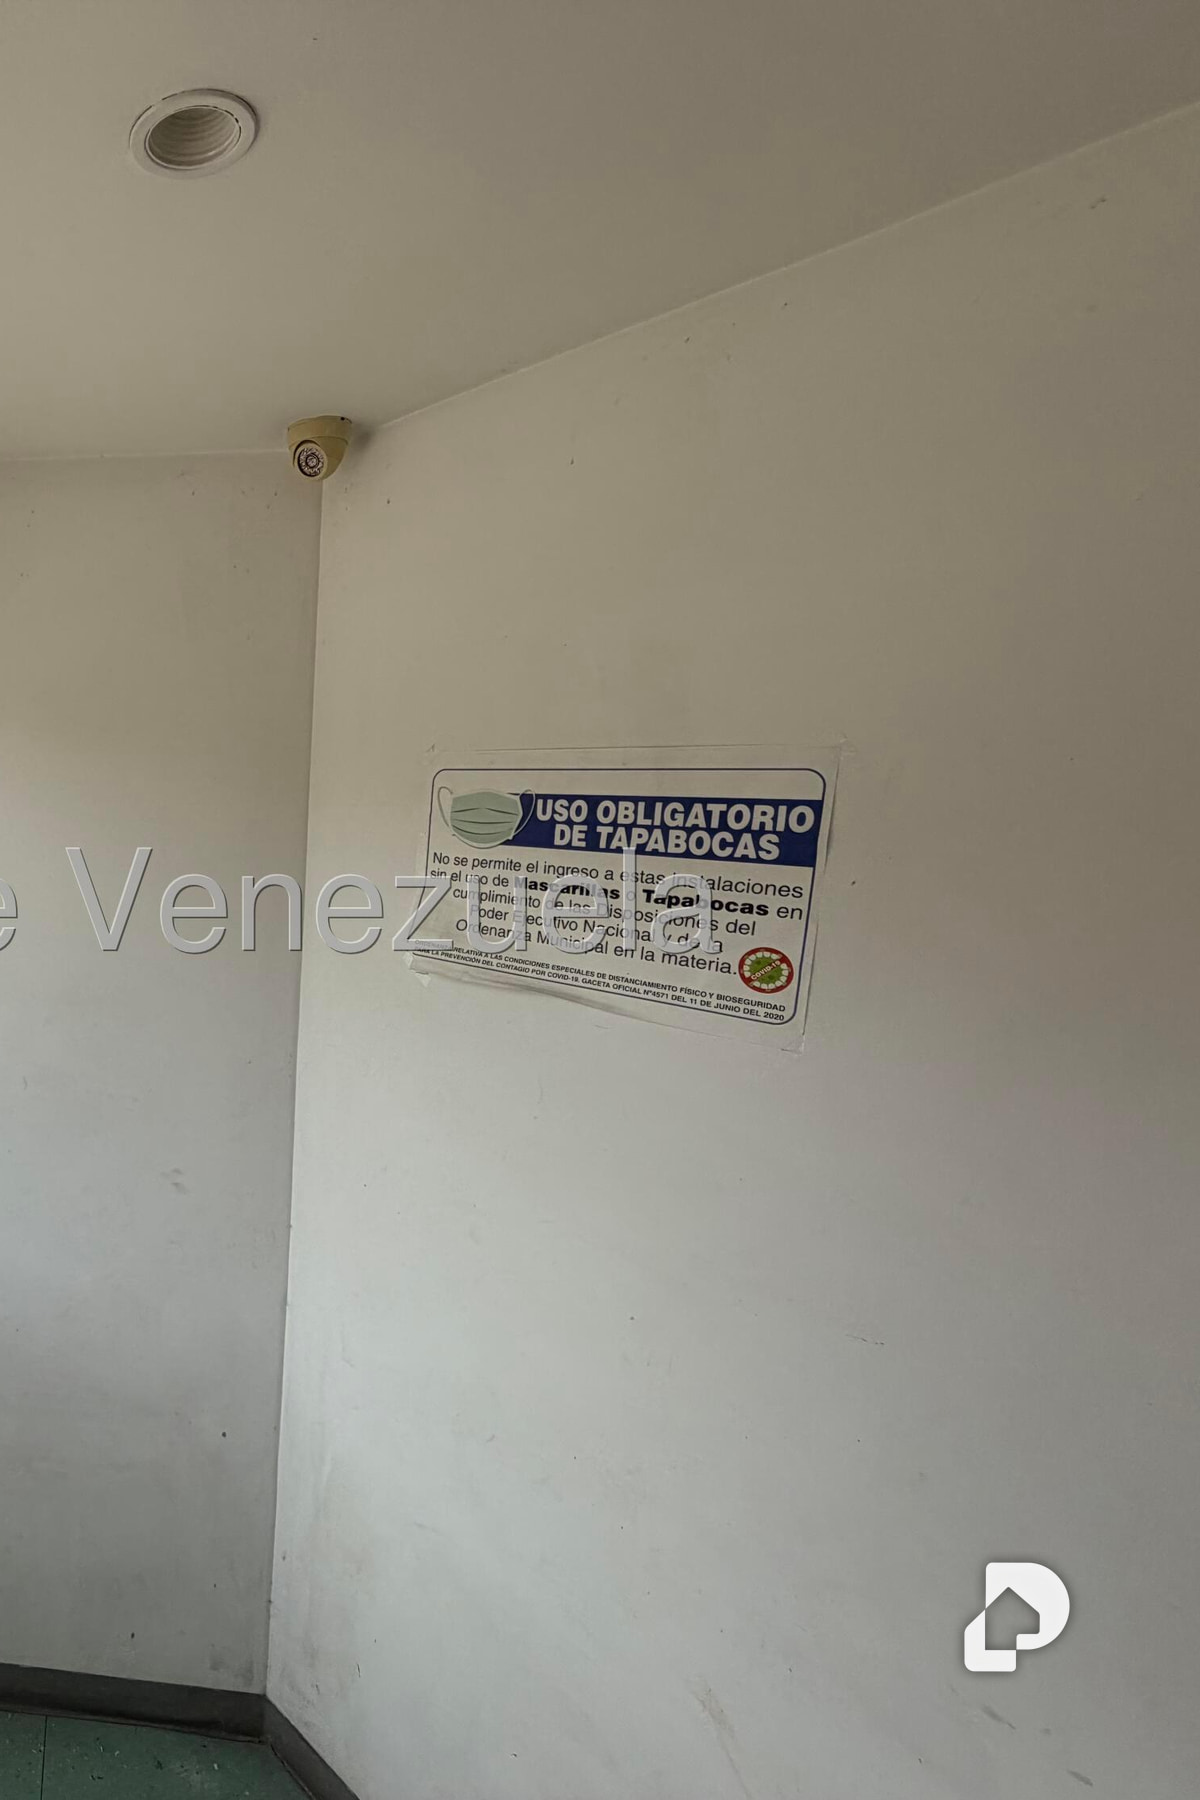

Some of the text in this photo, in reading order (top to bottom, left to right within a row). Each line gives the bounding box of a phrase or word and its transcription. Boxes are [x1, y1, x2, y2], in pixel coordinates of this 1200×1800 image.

[536, 798, 815, 834] USO OBLIGATORIO
[554, 823, 780, 861] DE TAPABOCAS
[430, 868, 447, 880] sin
[451, 871, 461, 882] el
[466, 873, 488, 885] uso
[493, 875, 509, 888] de
[514, 876, 621, 900] Mascarillas
[642, 888, 769, 916] Tapabocas
[776, 905, 804, 920] en
[433, 852, 804, 899] No se permite el ingreso a estas instalaciones
[453, 888, 756, 936] cumplimiento de las Disposiciones del
[471, 904, 509, 921] Poder
[514, 910, 578, 931] Ejecutivo
[583, 920, 655, 943] Nacional
[677, 933, 700, 948] de
[456, 918, 737, 976] Ordenanza Municipal en la materia.
[750, 959, 782, 981] COVID-19
[441, 951, 481, 964] PREVENCIÓN
[482, 959, 495, 967] DEL
[496, 961, 530, 974] CONTAGIO
[531, 968, 546, 977] POR
[581, 978, 610, 989] GACETA
[612, 983, 642, 995] OFICIAL
[671, 994, 687, 1003] DEL
[690, 997, 698, 1006] 11
[699, 999, 712, 1008] DE
[714, 1002, 741, 1014] JUNIO
[743, 1008, 761, 1018] DEL
[763, 1011, 785, 1021] 2020
[454, 946, 483, 958] RELATIVA
[490, 953, 503, 961] LAS
[504, 956, 550, 970] CONDICIONES
[551, 964, 595, 978] ESPECIALES
[596, 971, 607, 979] DE
[608, 974, 678, 993] DISTANCIAMIENTO
[680, 985, 707, 998] FÍSICO
[716, 993, 786, 1012] BIOSEGURIDAD
